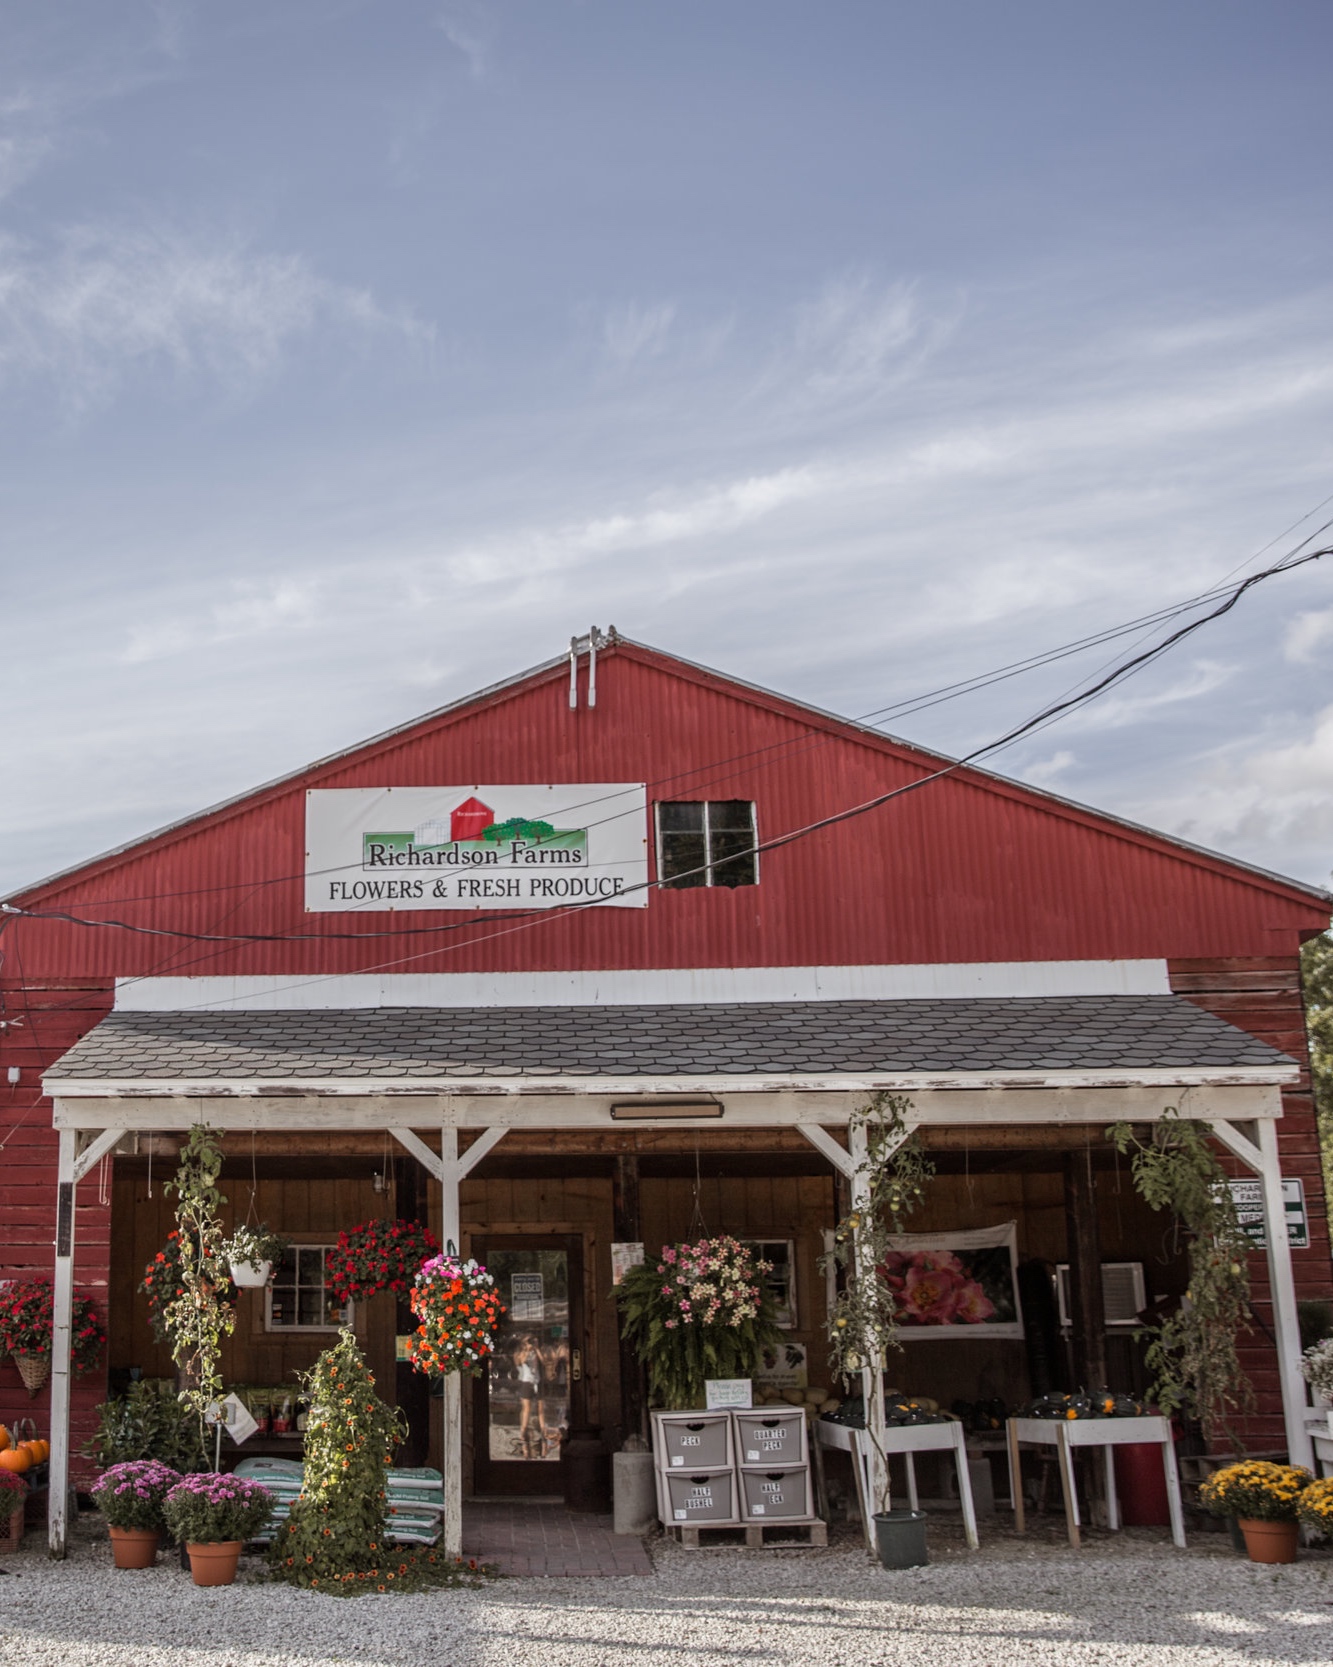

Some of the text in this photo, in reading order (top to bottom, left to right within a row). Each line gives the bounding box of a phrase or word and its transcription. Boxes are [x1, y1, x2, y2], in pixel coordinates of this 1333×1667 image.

[368, 841, 582, 866] Richardson Farms
[329, 877, 625, 900] FLOWERS & FRESH PRODUCE
[514, 1282, 541, 1292] CLOSED
[754, 1429, 787, 1440] QUARTER
[681, 1436, 700, 1446] PECK
[763, 1441, 782, 1451] PECK
[691, 1487, 711, 1497] HALF
[761, 1483, 781, 1493] HALF
[684, 1498, 713, 1509] BUSHEL
